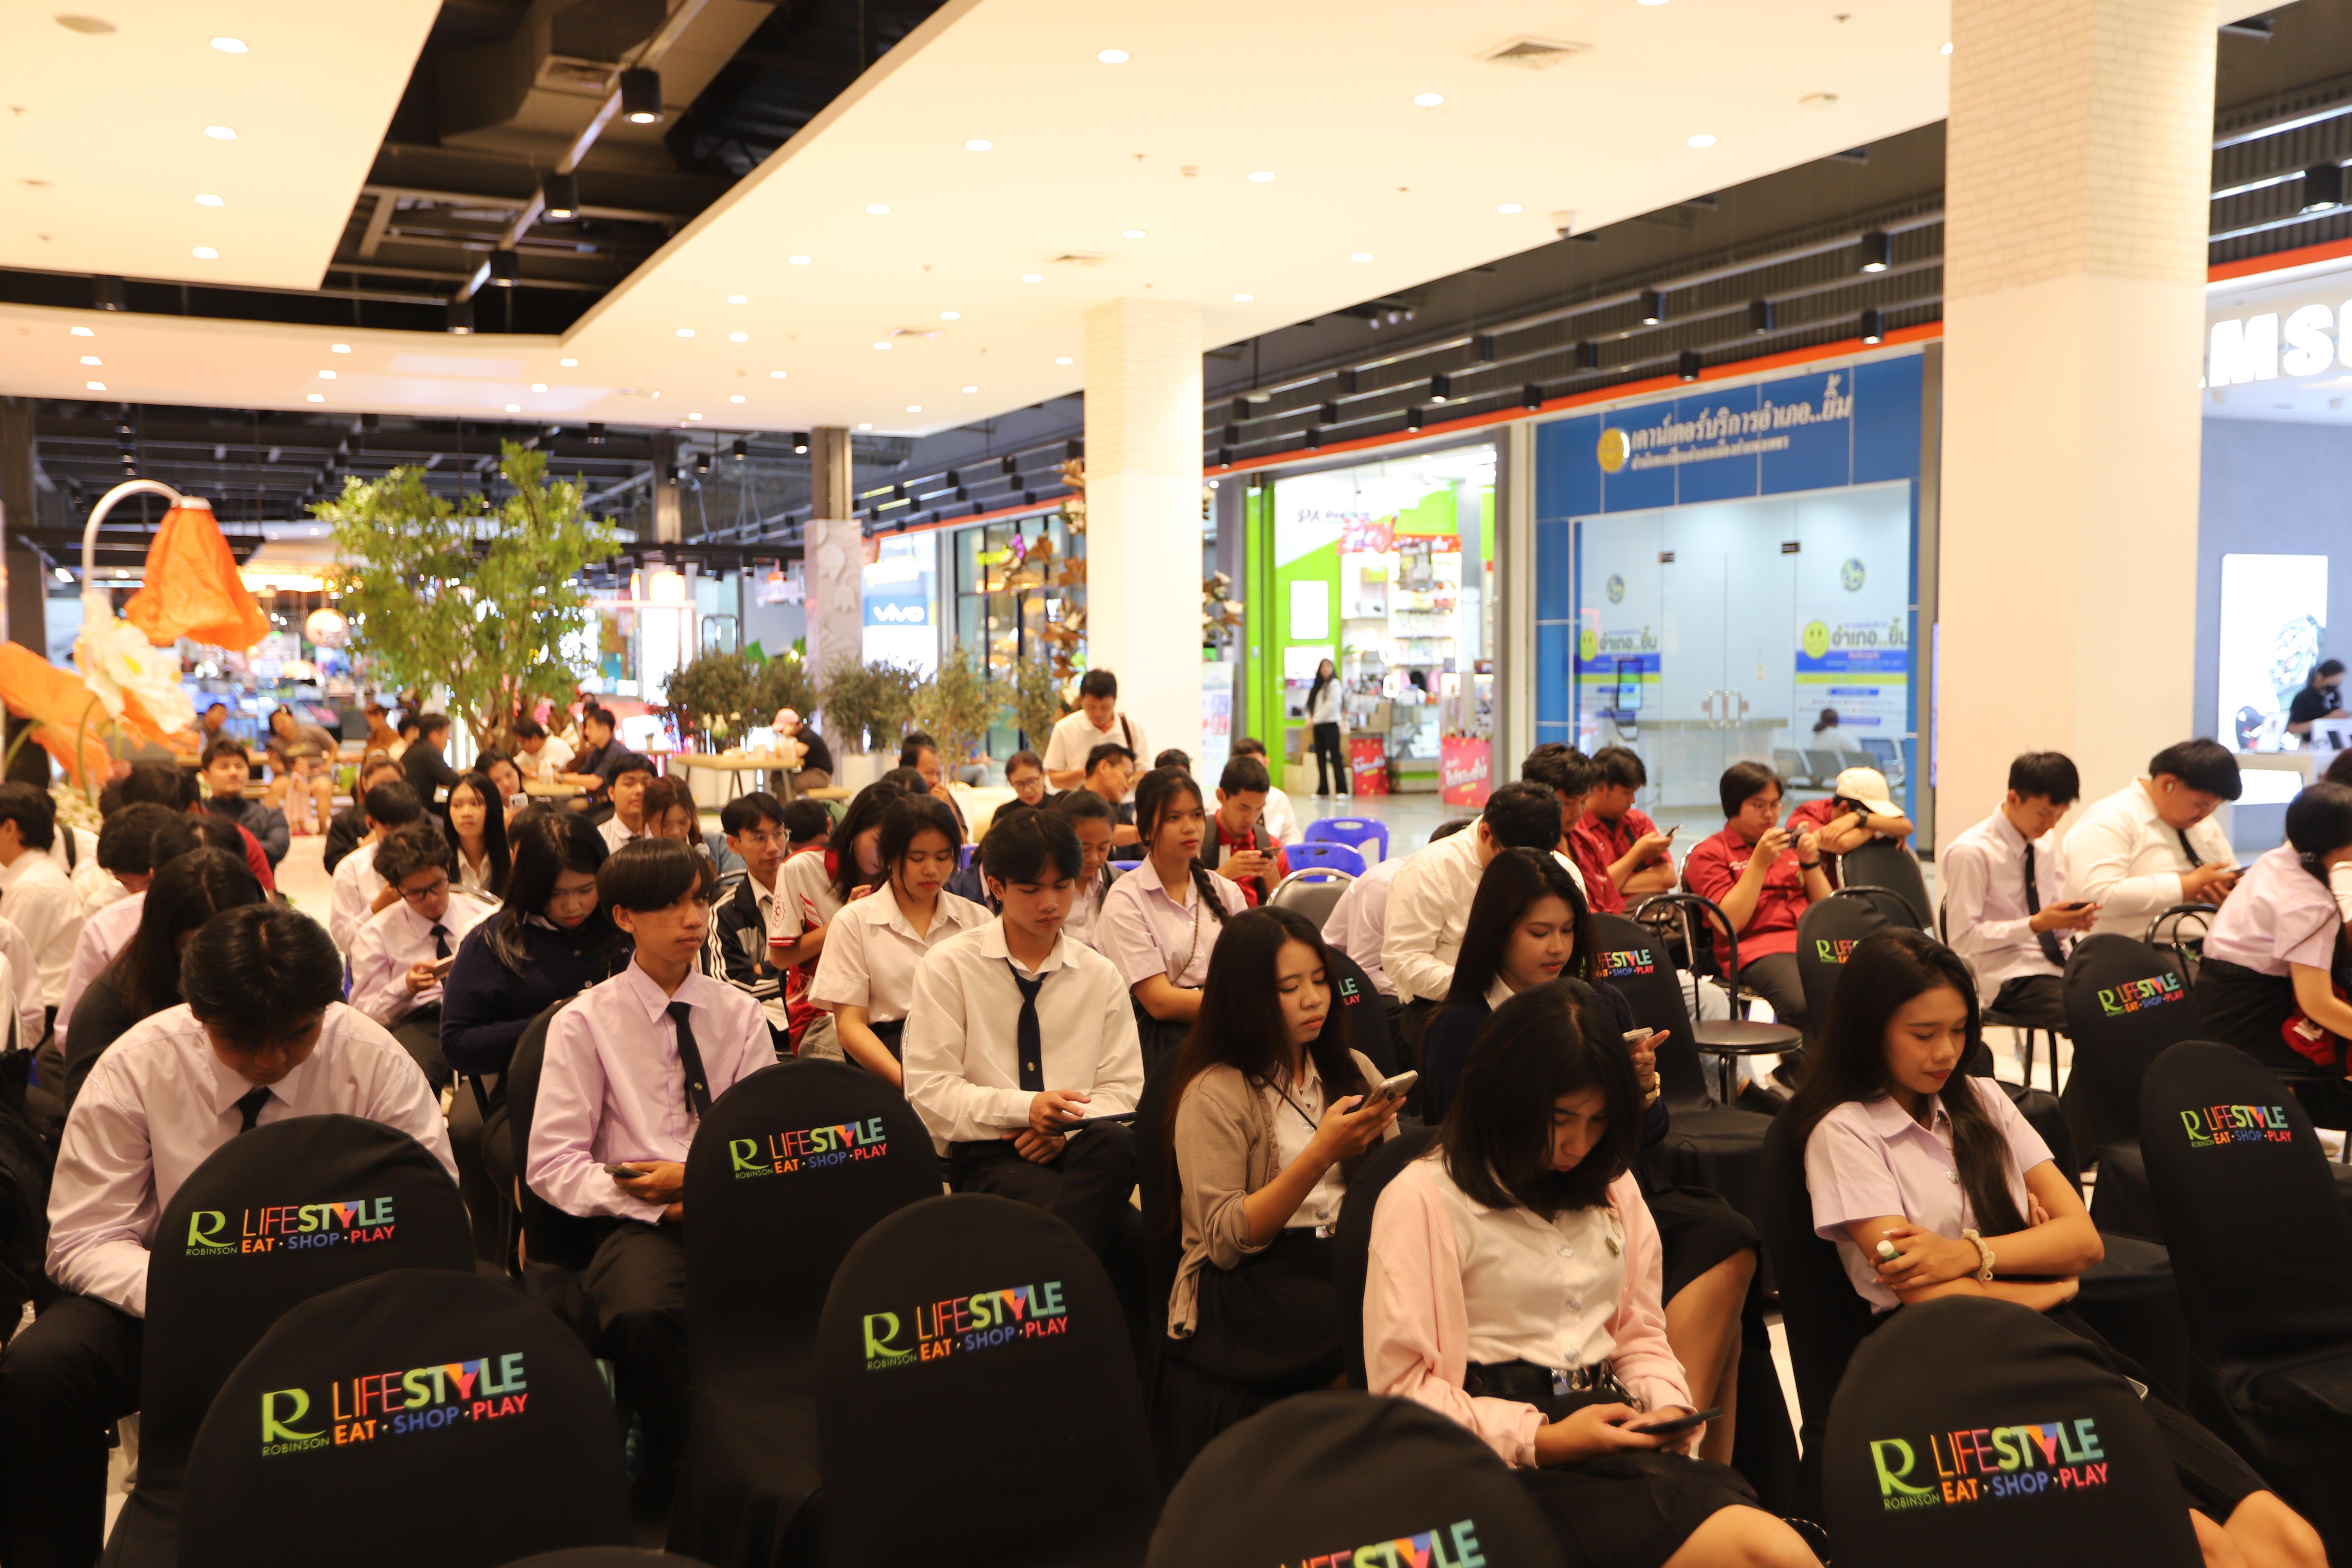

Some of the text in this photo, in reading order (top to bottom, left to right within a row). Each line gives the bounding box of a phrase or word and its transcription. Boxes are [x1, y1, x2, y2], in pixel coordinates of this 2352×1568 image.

[873, 603, 925, 622] vivo
[1816, 939, 1837, 960] R
[1612, 968, 1633, 976] SHOP
[1636, 965, 1654, 974] PLAY
[1339, 978, 1358, 996] LE
[1343, 994, 1360, 1005] LAY
[2097, 972, 2181, 1012] R LIFESTYLE
[2180, 1105, 2288, 1140] R LIFESTYLE
[730, 1117, 886, 1171] R LIFESTYLE
[2213, 1130, 2291, 1145] EAT SHOP PLAY
[775, 1143, 887, 1174] EAT SHOP PLAY
[736, 1168, 773, 1179] ROBINSON
[188, 1196, 394, 1247] R LIFESTYLE
[186, 1246, 237, 1256] ROBINSON
[242, 1225, 395, 1254] EAT SHOP PLAY
[864, 1281, 1066, 1358] R LIFESTYLE
[920, 1316, 1067, 1361] EAT SHOP PLAY
[867, 1353, 917, 1370] ROBINSON
[262, 1352, 527, 1442] R LIFESTYLE
[334, 1393, 528, 1445] EAT SHOP PLAY
[262, 1436, 330, 1457] ROBINSON
[1870, 1418, 2104, 1496] R LIFESTYLE
[1941, 1462, 2109, 1504] EAT SHOP PLAY
[1884, 1493, 1941, 1510] ROBINSON
